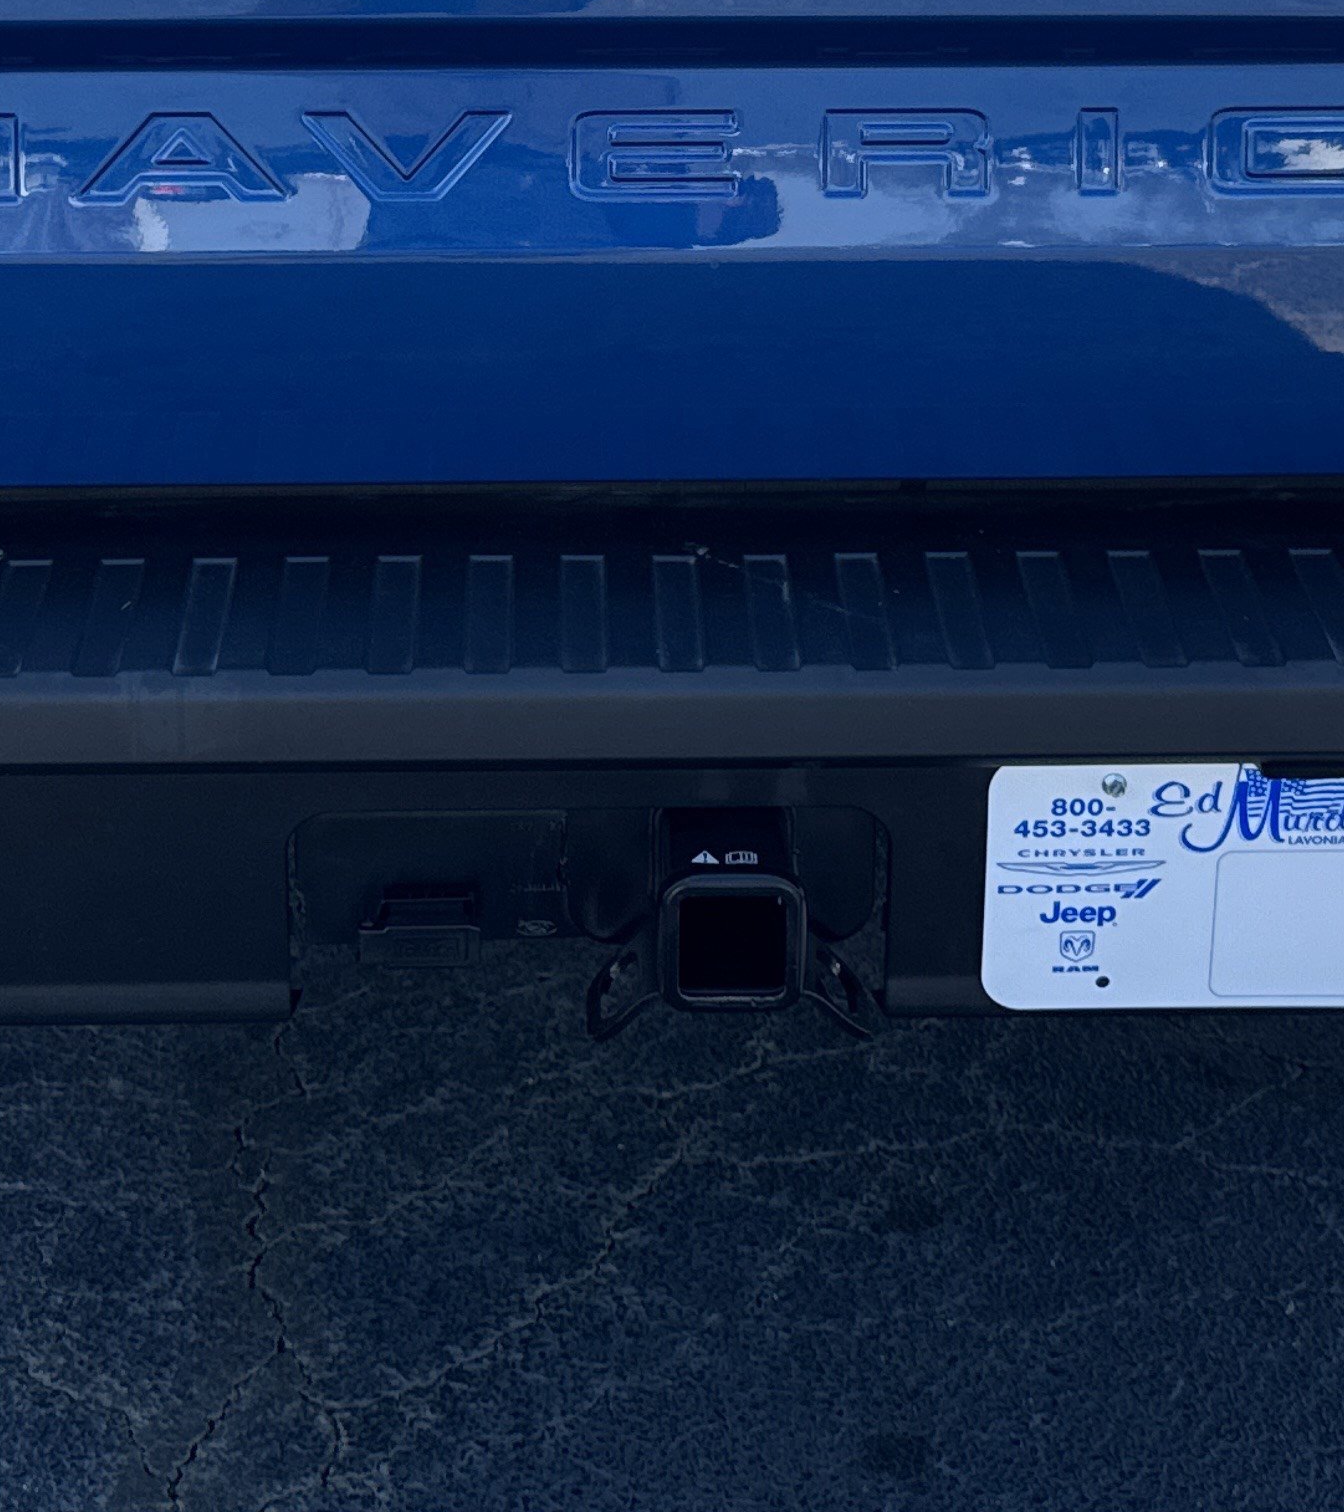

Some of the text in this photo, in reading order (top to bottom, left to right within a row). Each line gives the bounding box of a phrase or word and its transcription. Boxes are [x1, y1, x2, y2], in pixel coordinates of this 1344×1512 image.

[1050, 798, 1116, 817] 800-
[1147, 781, 1222, 817] Ed
[1013, 819, 1151, 838] 453-3433
[1017, 848, 1146, 858] CHRYSLER
[1039, 900, 1117, 927] Jeep
[1052, 965, 1099, 973] RAM
